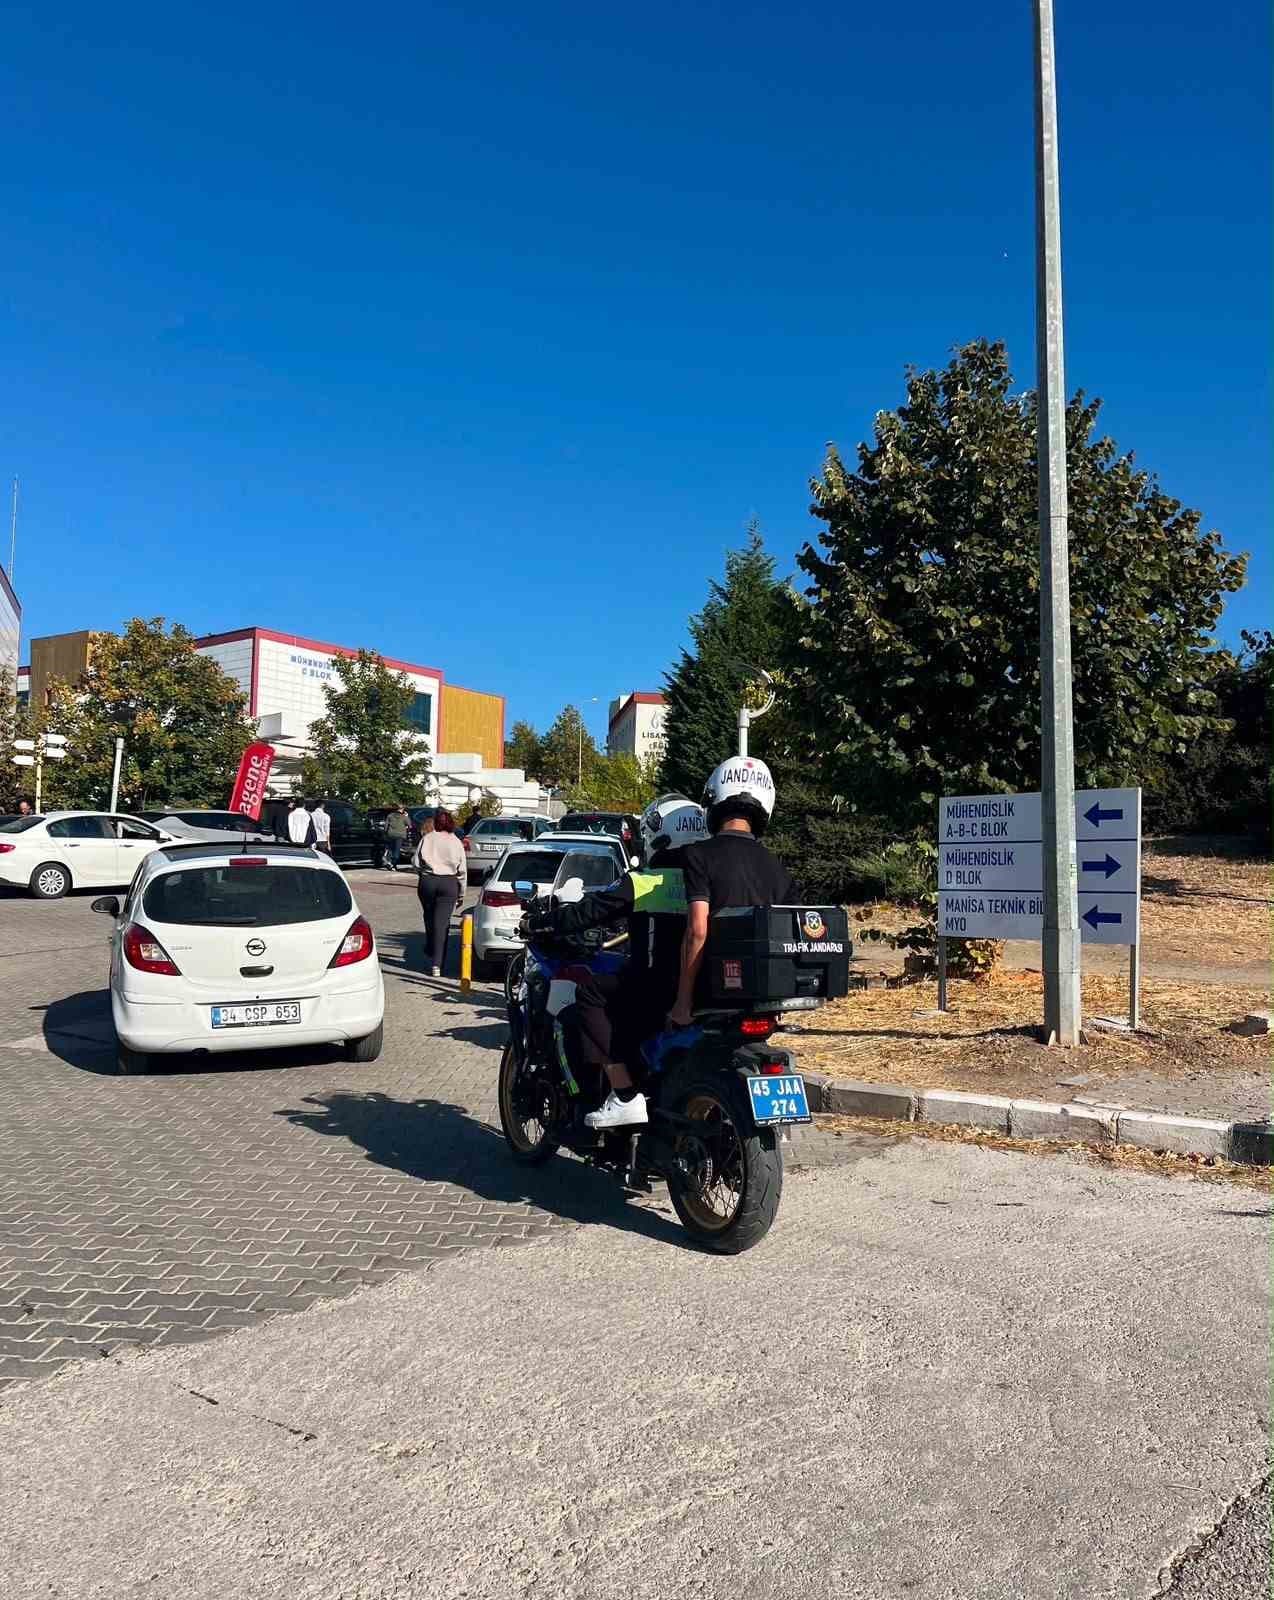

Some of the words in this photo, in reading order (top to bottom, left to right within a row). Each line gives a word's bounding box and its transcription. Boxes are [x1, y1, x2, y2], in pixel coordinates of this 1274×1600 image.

[310, 669, 332, 681] BLOK
[946, 799, 1015, 819] MÜHENDİSLİK
[946, 822, 978, 838] A-B-C
[980, 821, 1008, 837] BLOK
[945, 848, 1014, 866] MÜHENDİSLİK
[946, 870, 952, 885] D
[955, 870, 982, 885] BLOK
[945, 896, 985, 913] MANİSA
[987, 896, 1026, 914] TEKNİK
[945, 916, 967, 931] MYO
[222, 1008, 236, 1022] 34
[245, 1006, 268, 1020] CSP
[275, 1005, 298, 1019] 653
[753, 1080, 770, 1096] 45
[777, 1079, 801, 1095] JAA
[771, 1099, 797, 1116] 274
